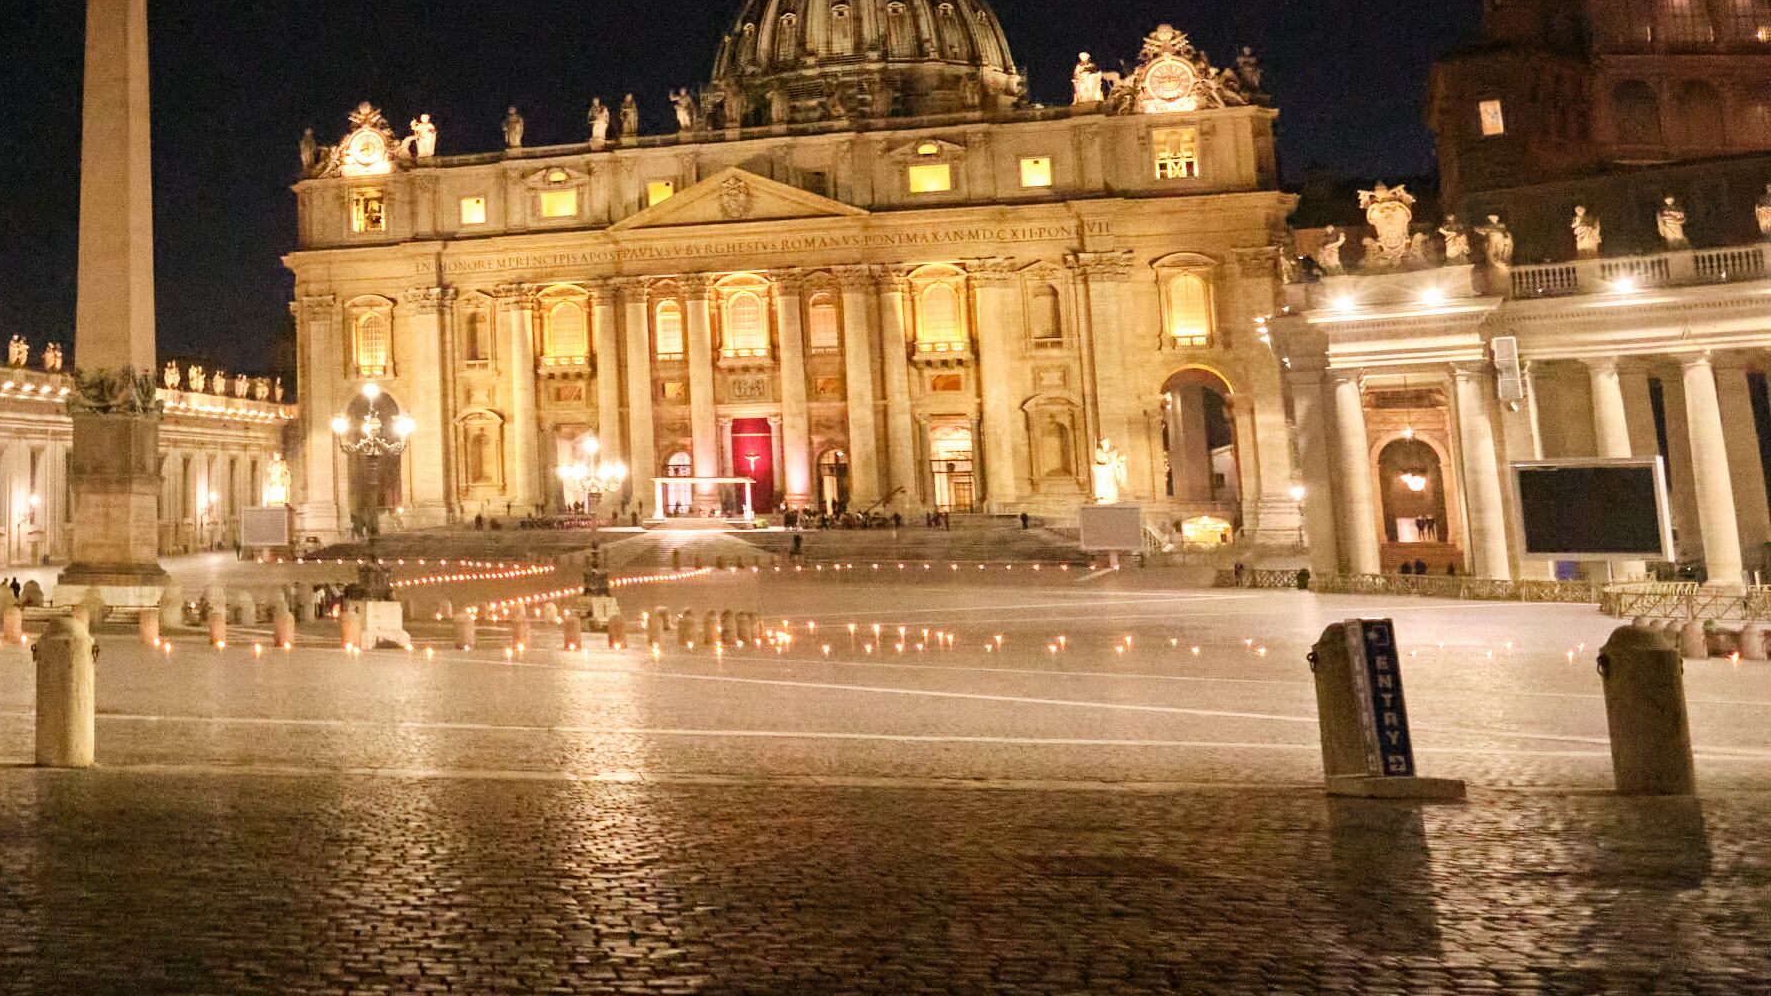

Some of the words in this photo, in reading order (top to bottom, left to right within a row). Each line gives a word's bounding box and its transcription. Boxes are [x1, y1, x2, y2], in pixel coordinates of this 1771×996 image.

[415, 262, 430, 272] IN
[508, 253, 577, 268] PRINCIPIS
[624, 246, 671, 259] PAVLVS
[685, 242, 777, 255] BVRGHESIVS
[781, 235, 860, 250] ROMANVS
[906, 232, 939, 243] MAX
[968, 228, 1032, 240] MDCXII
[1087, 221, 1109, 233] VII
[1375, 655, 1400, 745] ENTRY
